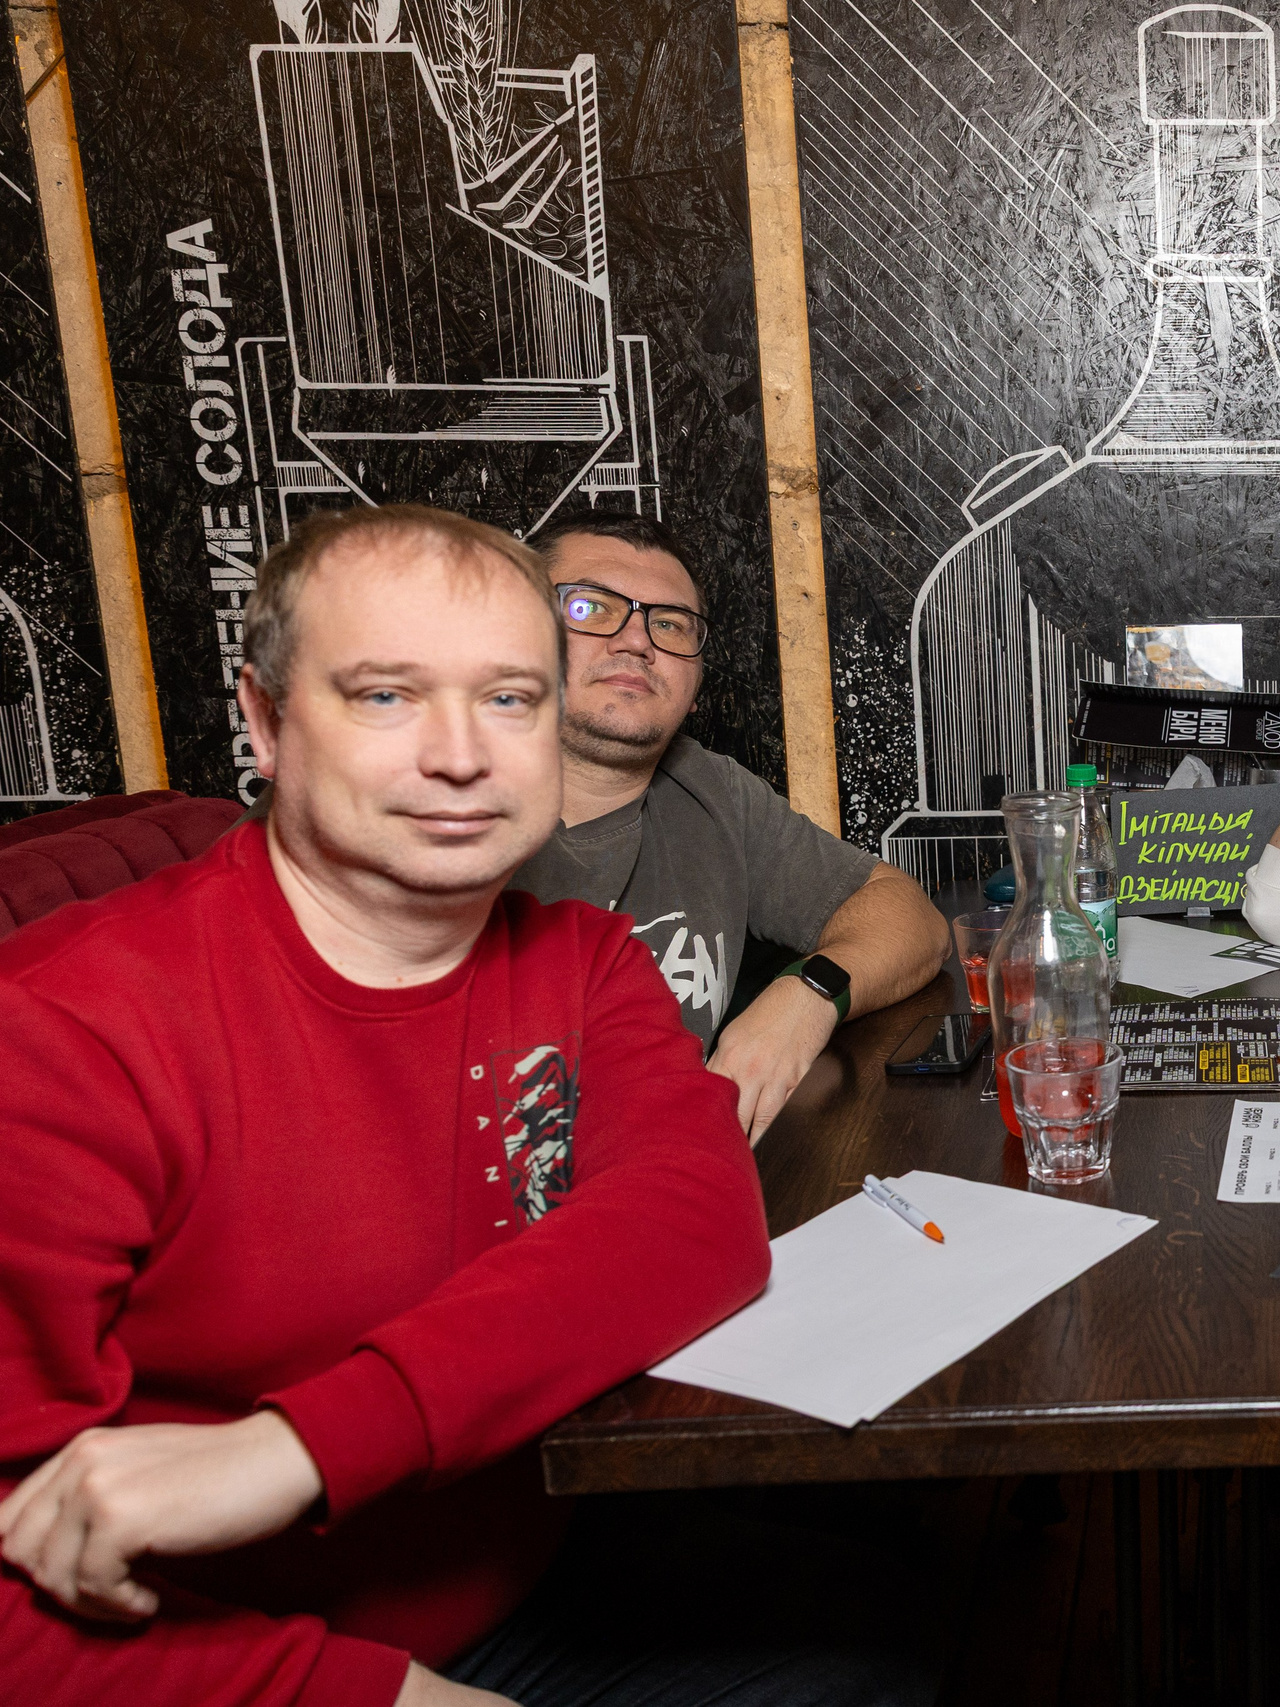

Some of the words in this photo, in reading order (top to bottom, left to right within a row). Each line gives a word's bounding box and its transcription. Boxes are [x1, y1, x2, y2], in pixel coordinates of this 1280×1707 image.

[166, 218, 243, 486] СОЛОДА
[1168, 710, 1199, 741] БАРА
[1198, 708, 1228, 744] МЕНЮ
[1242, 1107, 1253, 1123] МАМА
